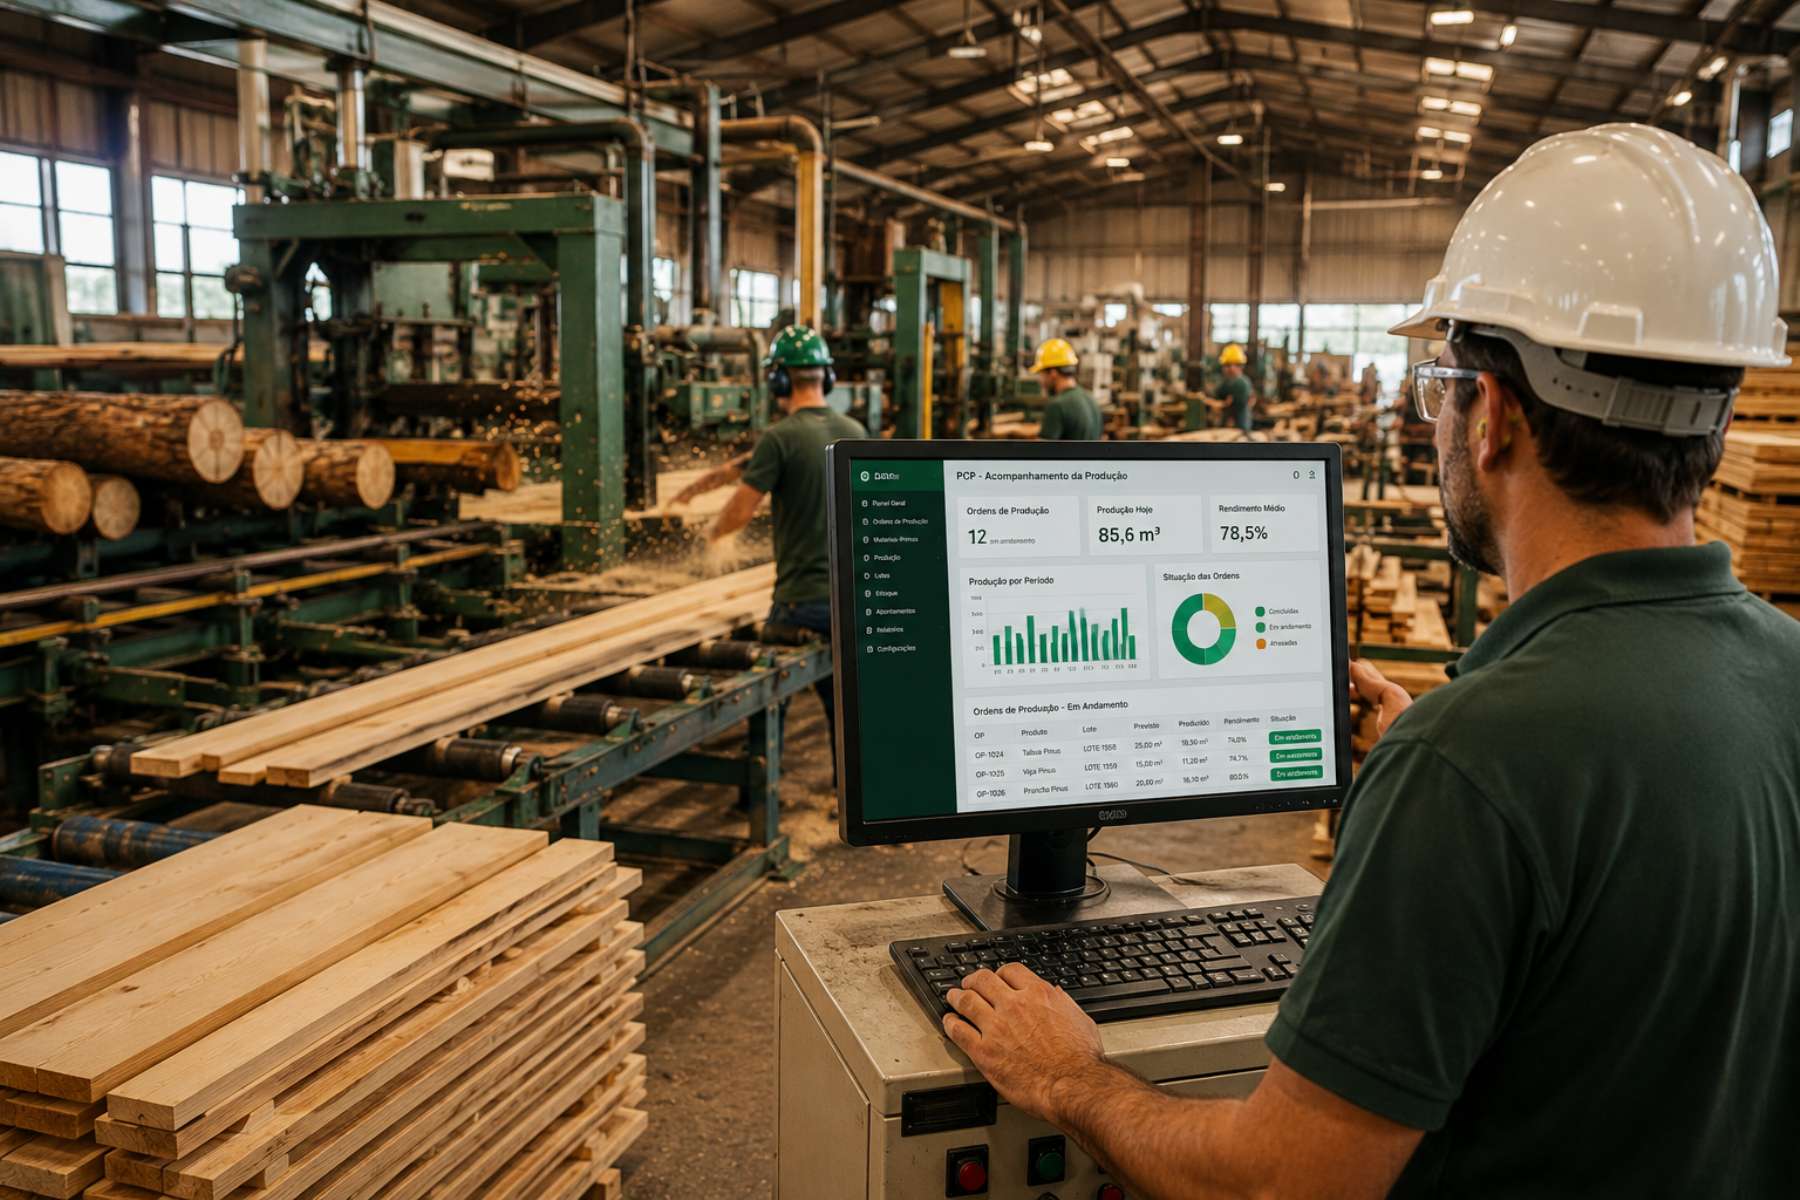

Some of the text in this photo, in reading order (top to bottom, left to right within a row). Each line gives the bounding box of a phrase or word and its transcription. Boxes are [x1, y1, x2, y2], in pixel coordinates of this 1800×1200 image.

[956, 472, 976, 481] PCP
[985, 471, 1069, 481] Acompanhamento
[1072, 472, 1083, 480] da
[1085, 471, 1128, 481] Produção
[966, 506, 1050, 516] Ordens de Produção
[1097, 506, 1153, 515] Produção Hoje
[1219, 504, 1285, 513] Rendimento Médio
[968, 529, 987, 544] 12
[1099, 526, 1161, 545] 85,6 m³
[1220, 526, 1268, 542] 78,5%
[969, 577, 1007, 587] Produção
[1009, 578, 1022, 586] por
[1163, 573, 1196, 583] Situação
[1213, 572, 1240, 580] Ordens
[973, 708, 1003, 716] Ordens
[1067, 703, 1080, 711] Em
[1082, 702, 1128, 710] Andamento
